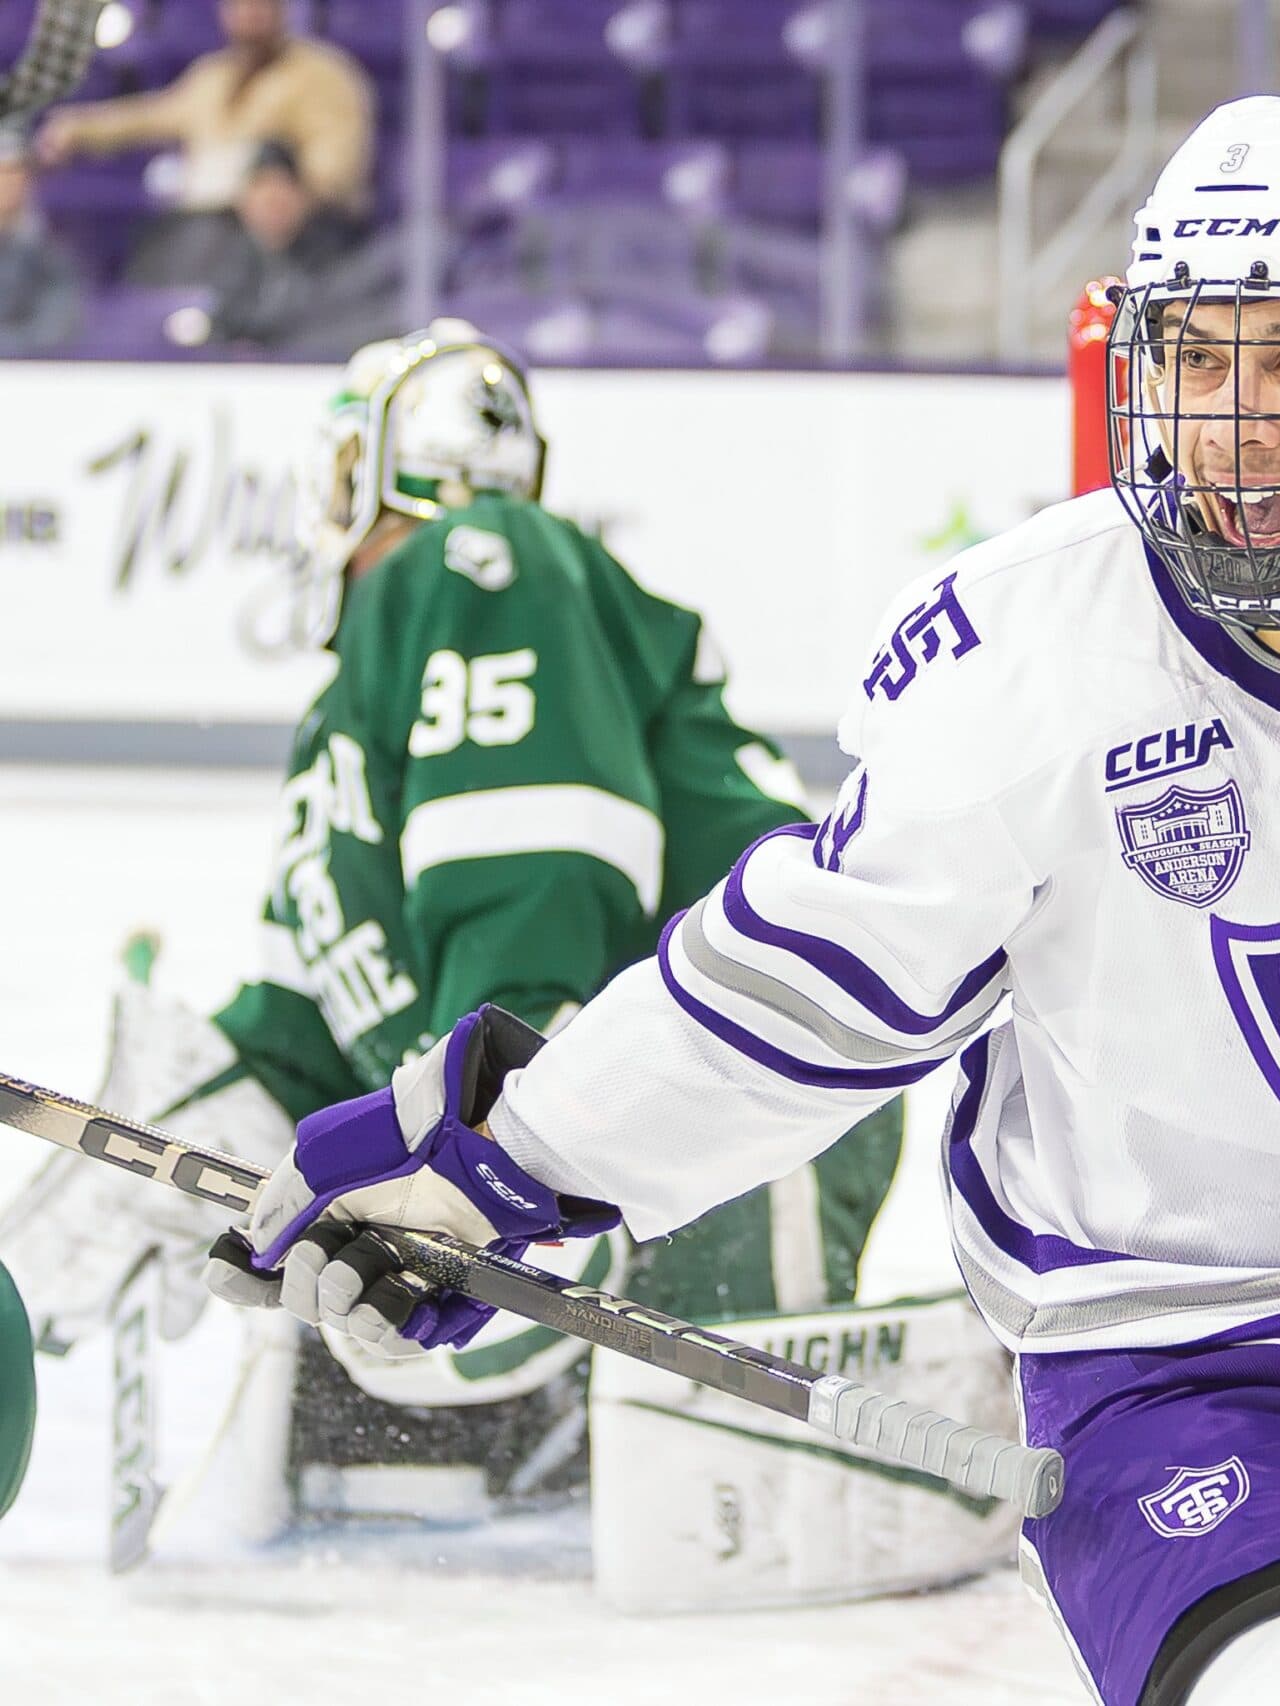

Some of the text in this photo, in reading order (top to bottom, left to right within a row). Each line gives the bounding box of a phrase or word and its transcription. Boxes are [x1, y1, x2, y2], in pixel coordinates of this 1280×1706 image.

[1219, 143, 1251, 174] 3
[408, 648, 538, 759] 35
[1105, 718, 1235, 783] CCHA
[1133, 838, 1241, 863] INAUGURAL SEASON
[1154, 851, 1227, 876] ANDERSON
[1168, 866, 1219, 887] ARENA
[478, 1162, 538, 1210] CCM
